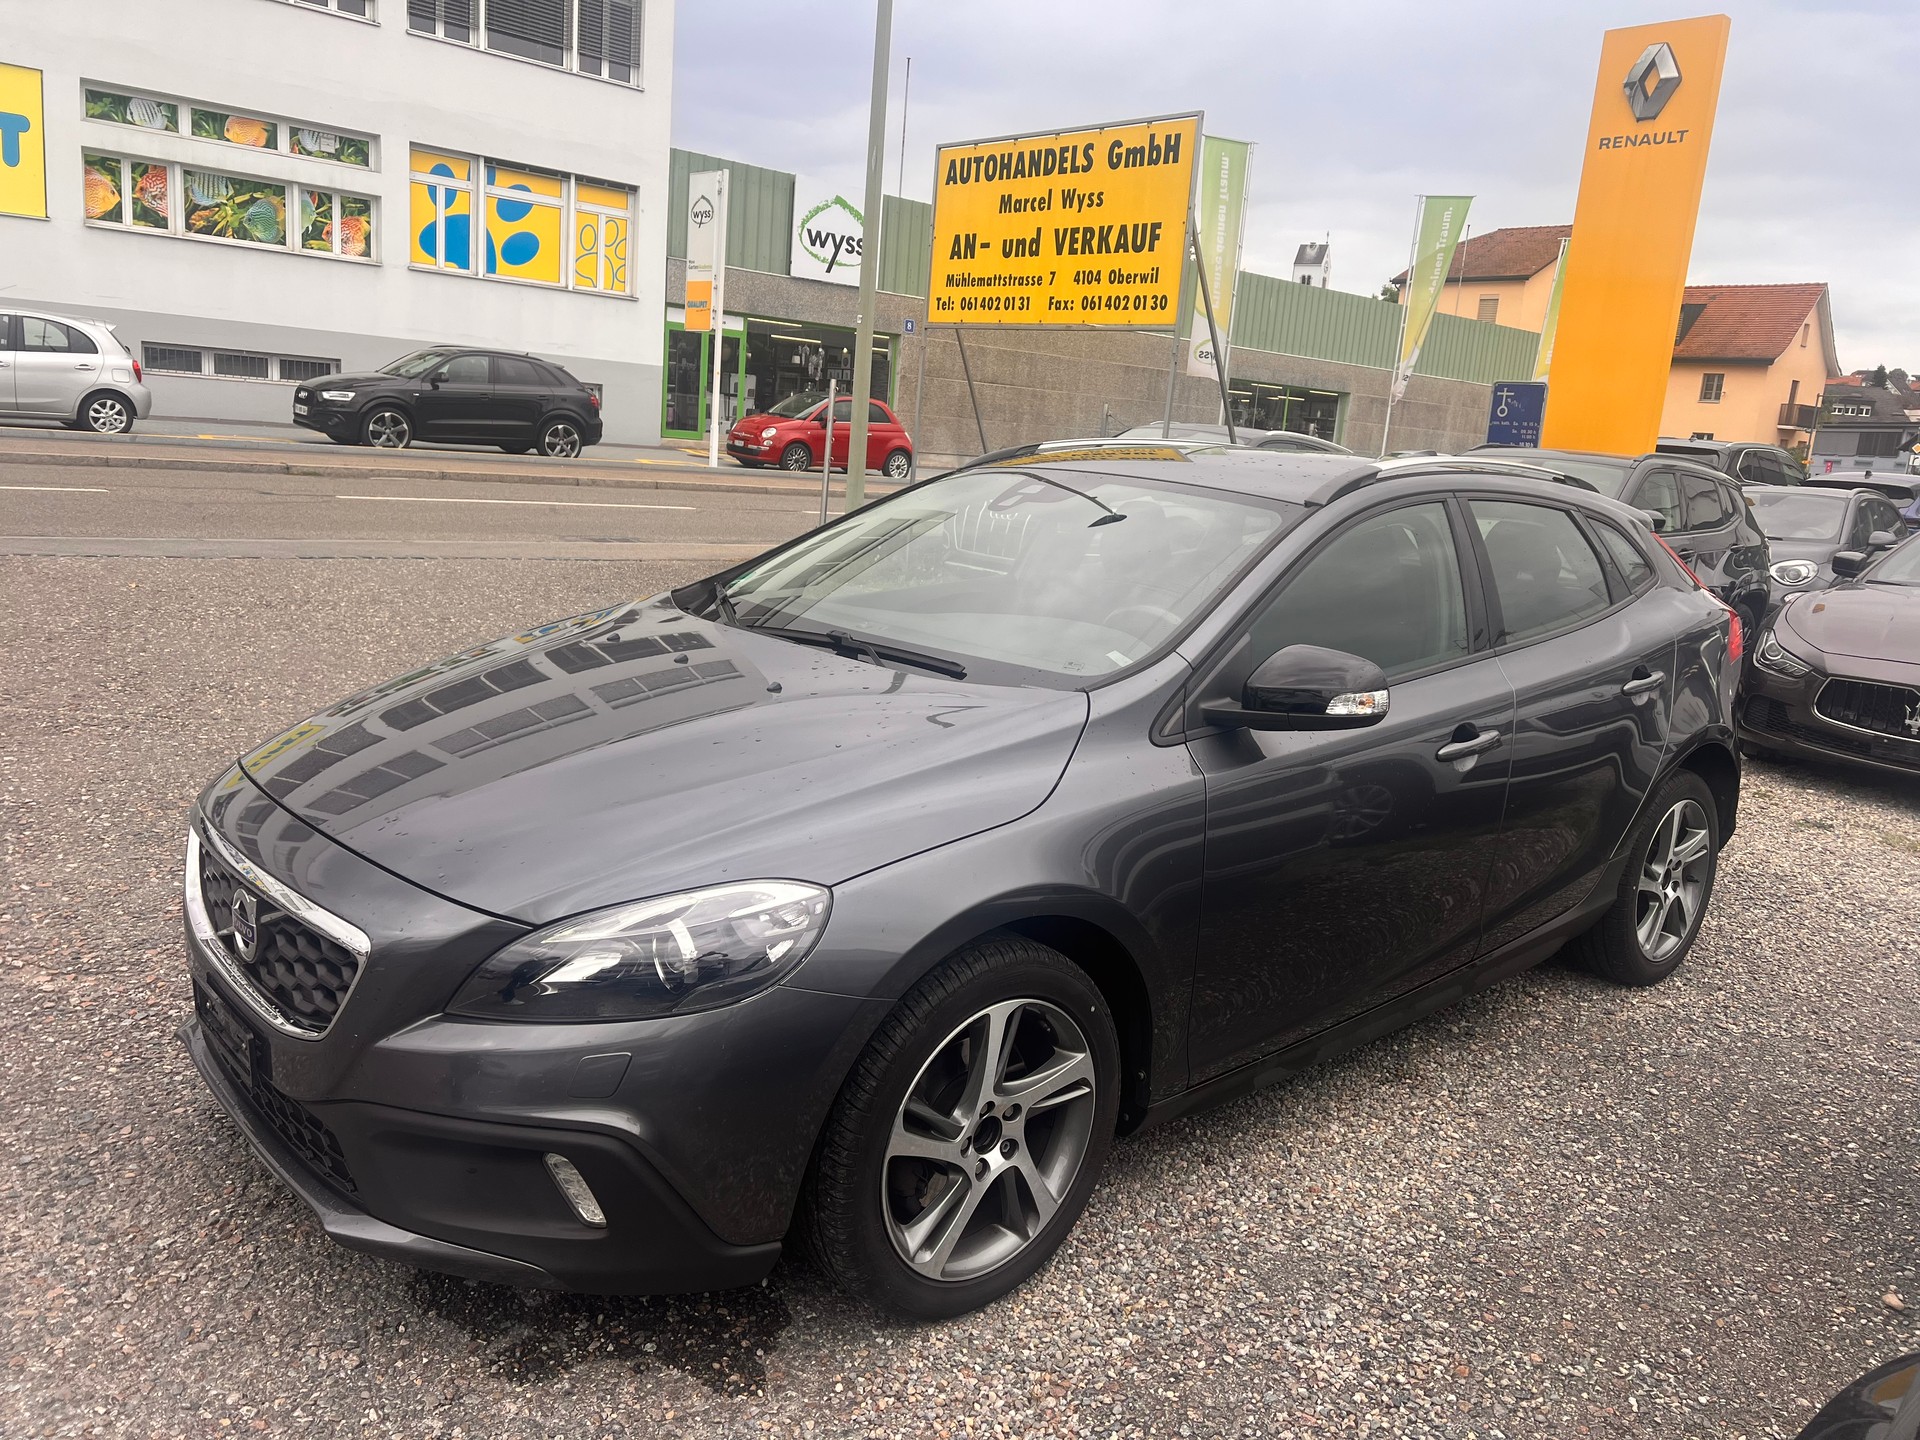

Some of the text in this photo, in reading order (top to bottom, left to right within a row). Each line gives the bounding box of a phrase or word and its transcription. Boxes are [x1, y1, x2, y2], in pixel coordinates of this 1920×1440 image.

[1598, 129, 1690, 150] RENAULT
[944, 132, 1182, 186] AUTOHANDELS GmbH
[998, 187, 1105, 214] Marcel Wyss
[692, 209, 711, 229] wyss
[1436, 206, 1454, 250] Traum.
[1001, 226, 1042, 259] und
[1053, 221, 1163, 256] VERKAUF
[945, 266, 1160, 288] Mühlemattstrasse 7 4104 Oberwil
[936, 296, 955, 311] Tel:
[1048, 296, 1075, 311] Fax:
[906, 321, 912, 331] 8
